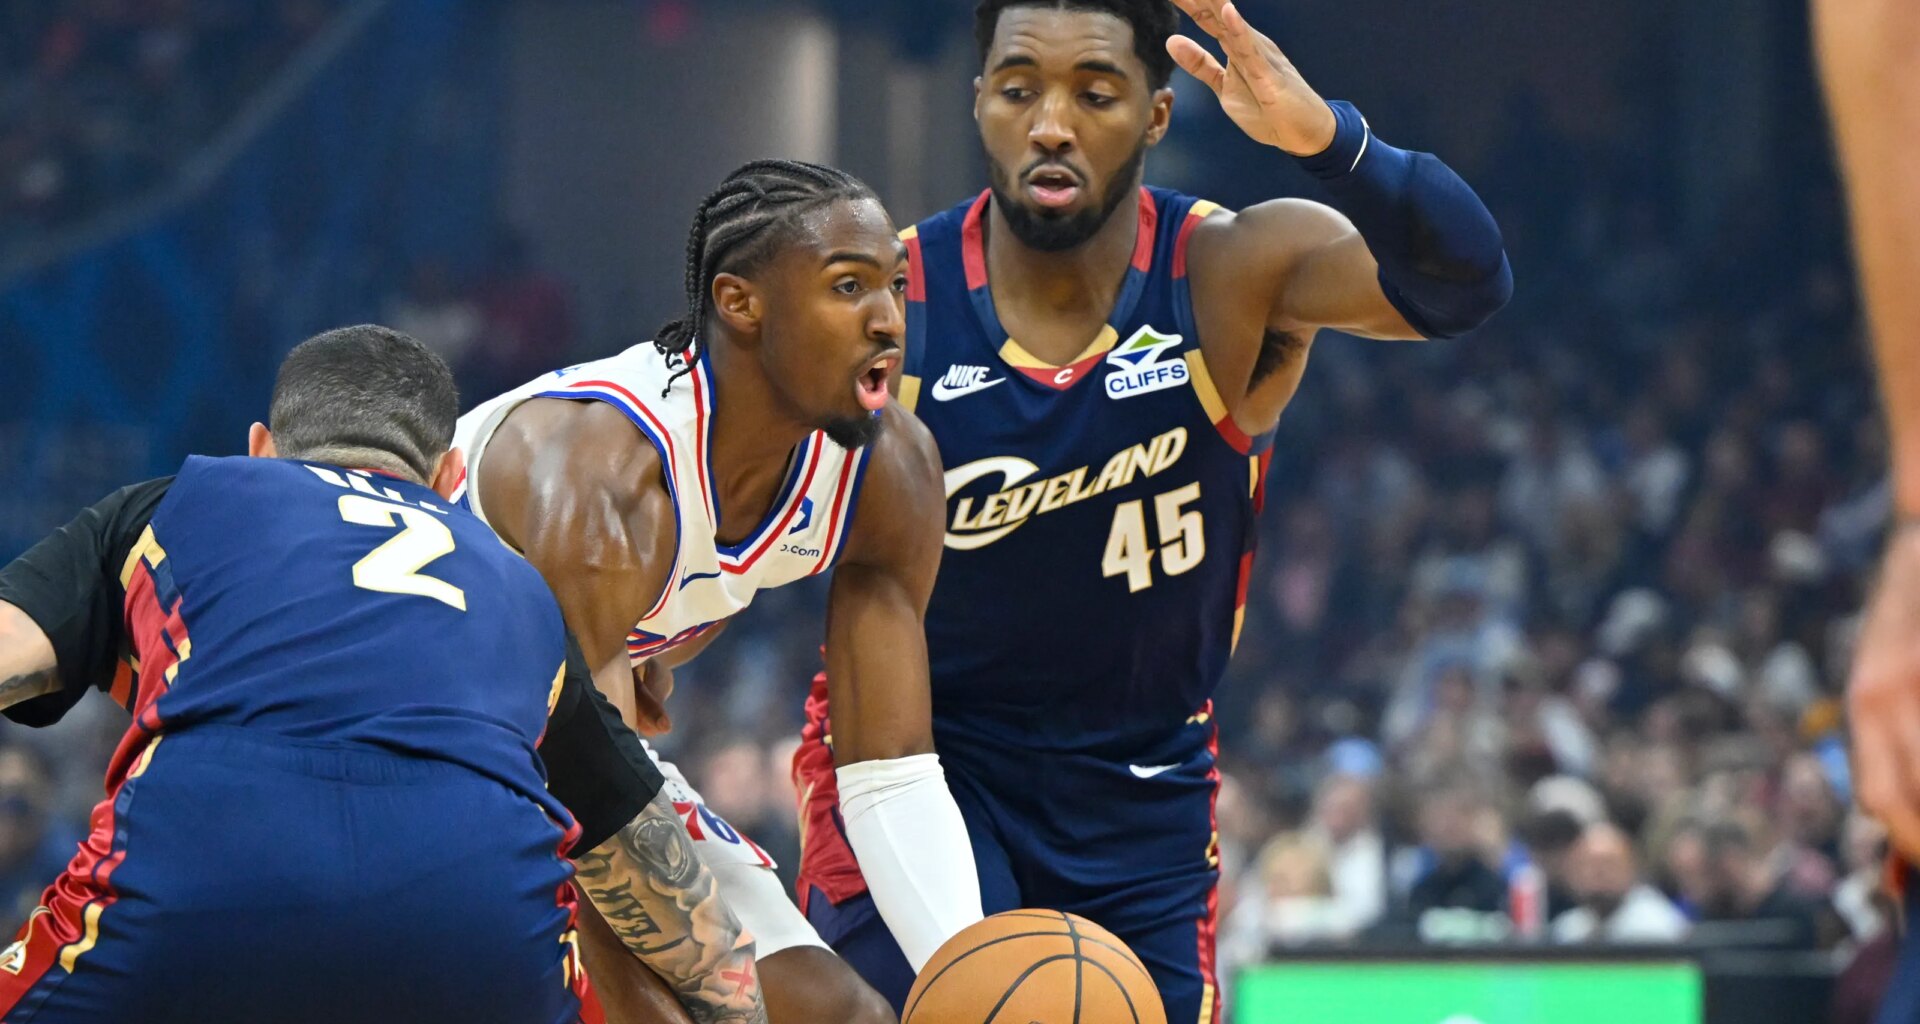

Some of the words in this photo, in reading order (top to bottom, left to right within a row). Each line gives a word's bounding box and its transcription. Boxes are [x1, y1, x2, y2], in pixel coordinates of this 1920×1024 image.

[943, 364, 990, 387] NIKE
[1053, 368, 1074, 385] C
[1109, 364, 1186, 393] CLIFFS
[943, 426, 1188, 550] CLEVELAND
[337, 494, 467, 612] 2
[1101, 480, 1205, 594] 45
[672, 801, 741, 845] 76
